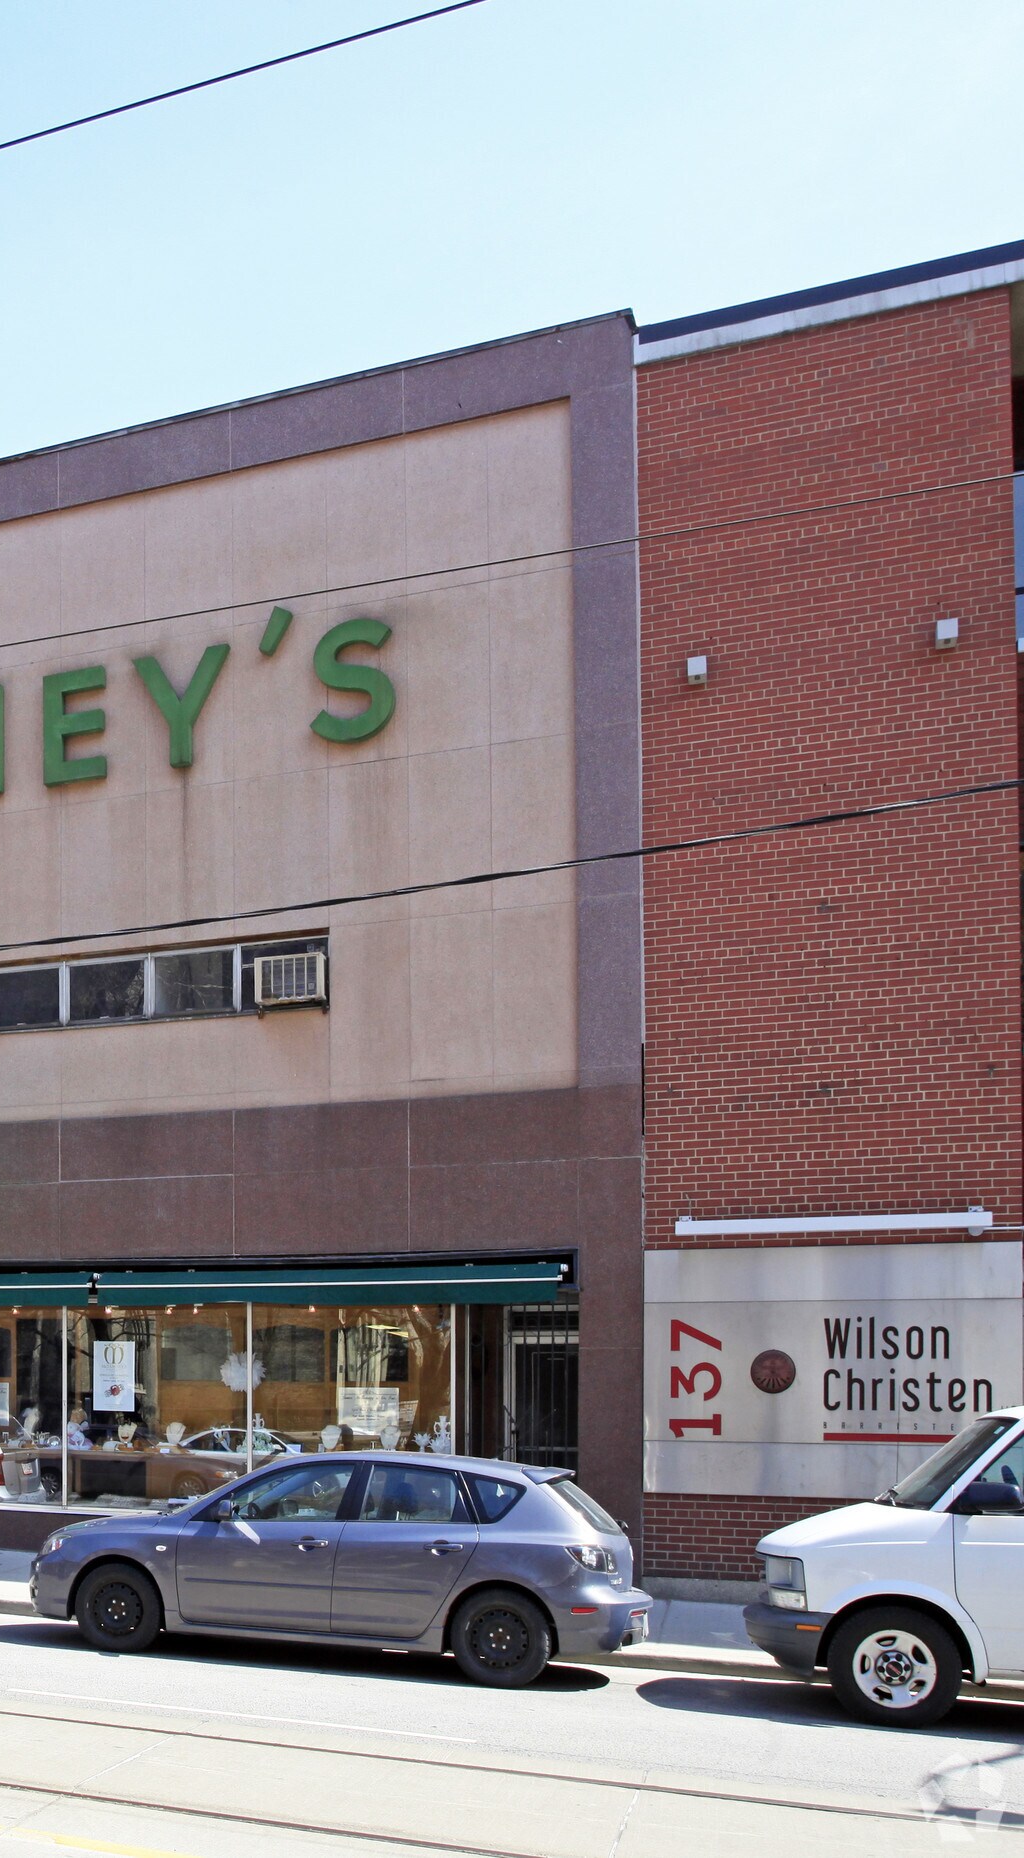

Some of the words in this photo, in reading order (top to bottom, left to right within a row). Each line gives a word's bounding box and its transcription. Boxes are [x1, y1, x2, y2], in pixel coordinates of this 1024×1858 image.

[823, 1316, 950, 1360] Wilson
[668, 1319, 722, 1439] 137
[823, 1368, 993, 1413] Christen
